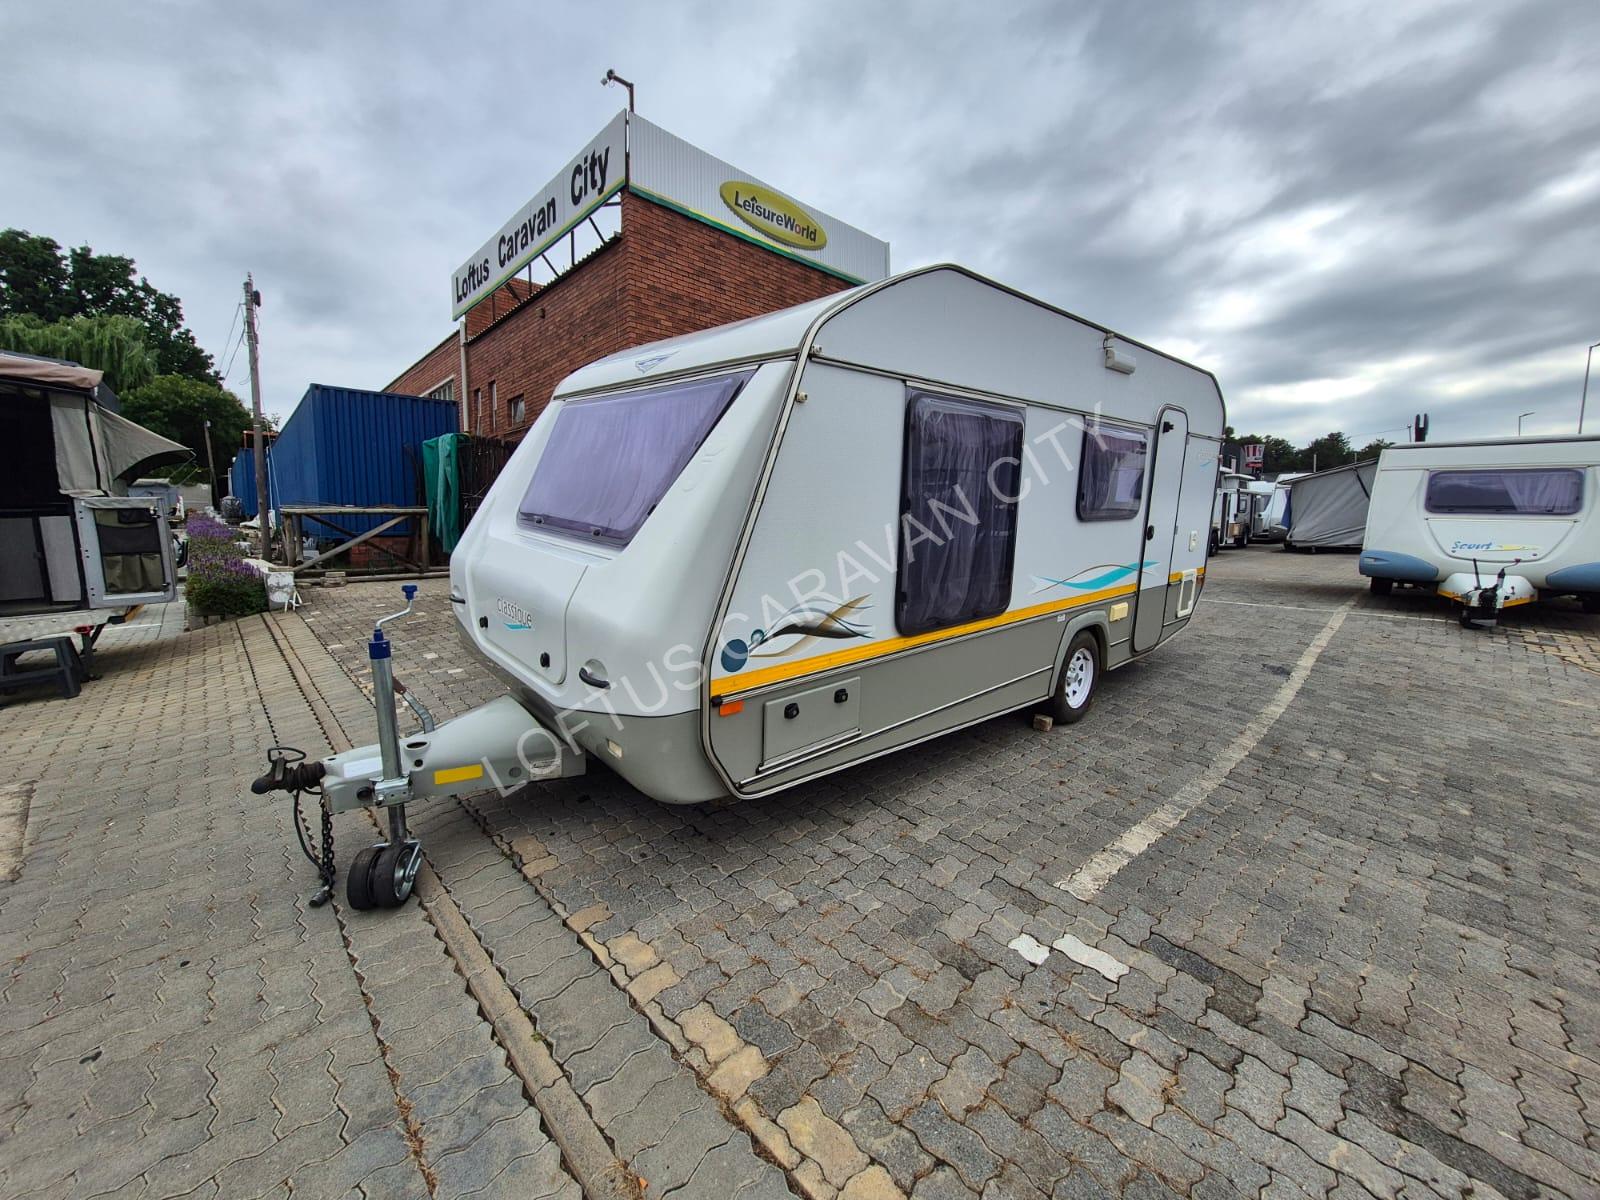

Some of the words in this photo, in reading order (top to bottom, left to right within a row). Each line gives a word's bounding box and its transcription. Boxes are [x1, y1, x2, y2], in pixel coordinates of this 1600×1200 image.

[455, 258, 490, 304] Loftus
[498, 197, 556, 268] Caravan
[570, 146, 610, 206] City
[734, 190, 817, 243] LeisureWorld
